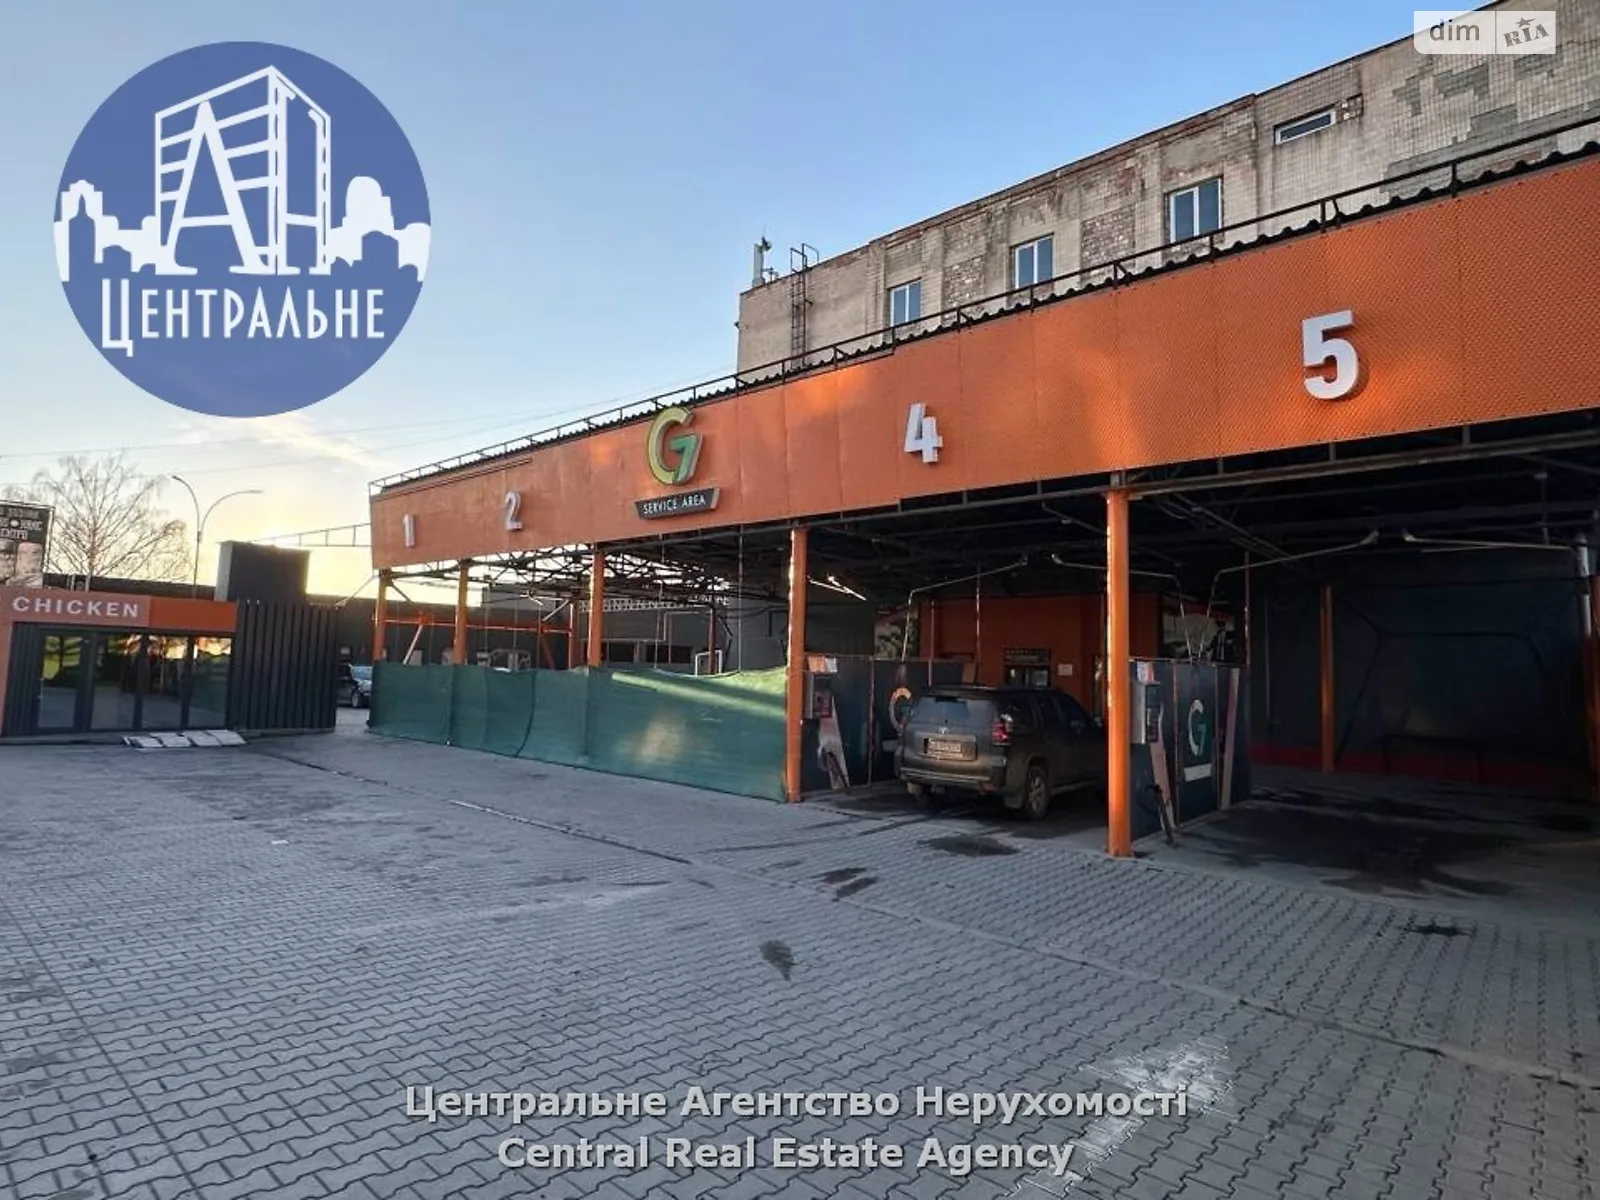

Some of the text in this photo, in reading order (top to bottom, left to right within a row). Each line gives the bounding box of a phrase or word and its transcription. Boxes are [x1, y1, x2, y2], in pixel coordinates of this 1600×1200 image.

[1302, 309, 1360, 400] 5
[904, 403, 943, 463] 4
[505, 491, 522, 531] 2
[643, 494, 706, 514] SERVICE AREA
[402, 513, 415, 547] 1
[12, 595, 140, 619] CHICKEN
